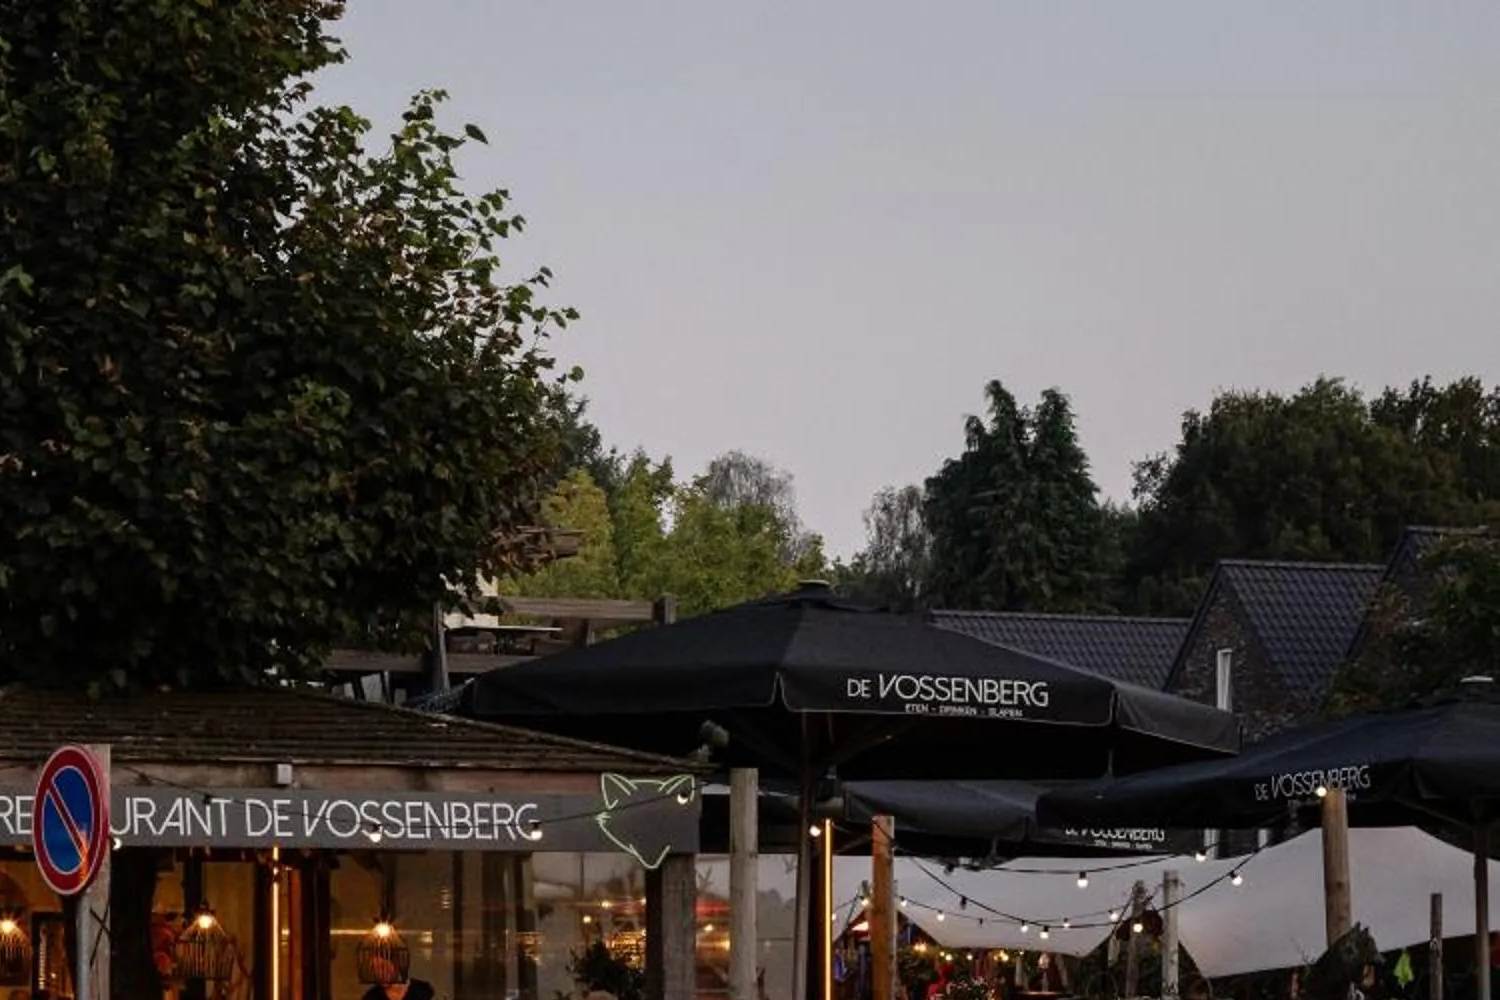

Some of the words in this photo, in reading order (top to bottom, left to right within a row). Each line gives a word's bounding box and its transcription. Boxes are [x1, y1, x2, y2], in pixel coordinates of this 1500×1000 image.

[847, 678, 871, 698] DE
[879, 674, 1049, 707] VOSSENBERG
[245, 799, 294, 837] DE
[302, 799, 539, 840] VOSSENBERG
